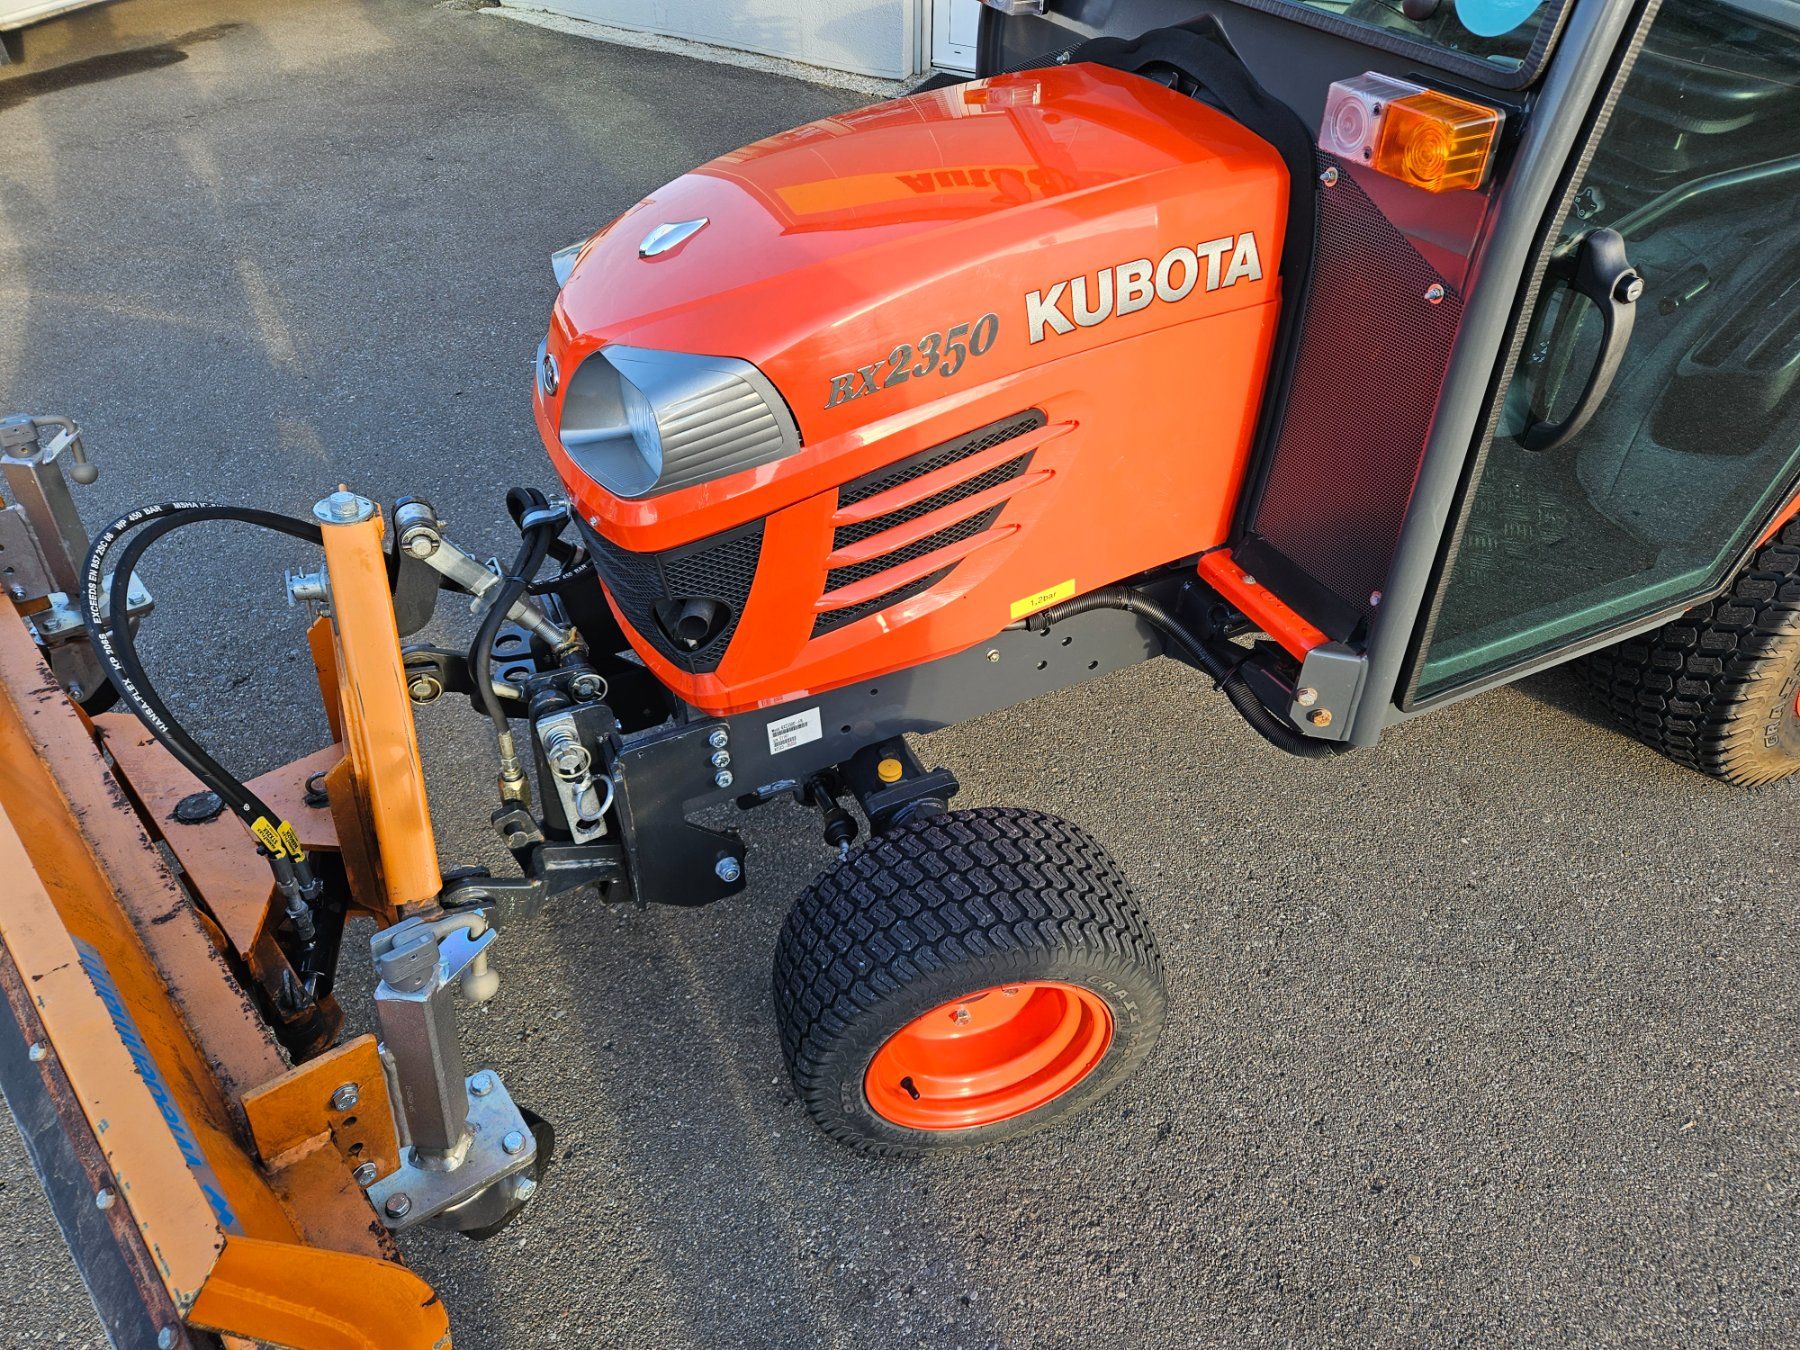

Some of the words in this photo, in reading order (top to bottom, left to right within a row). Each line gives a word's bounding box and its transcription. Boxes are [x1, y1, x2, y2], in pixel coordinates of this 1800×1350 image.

[1024, 231, 1263, 344] KUBOTA
[824, 313, 999, 410] BX2350
[143, 505, 163, 516] BAR
[172, 501, 199, 509] MSHA
[128, 511, 143, 522] 450
[114, 519, 127, 531] WP
[88, 568, 98, 582] EN
[88, 582, 102, 624] EXCEEDS
[110, 656, 122, 670] KP
[122, 677, 169, 733] HANSA-FLEX
